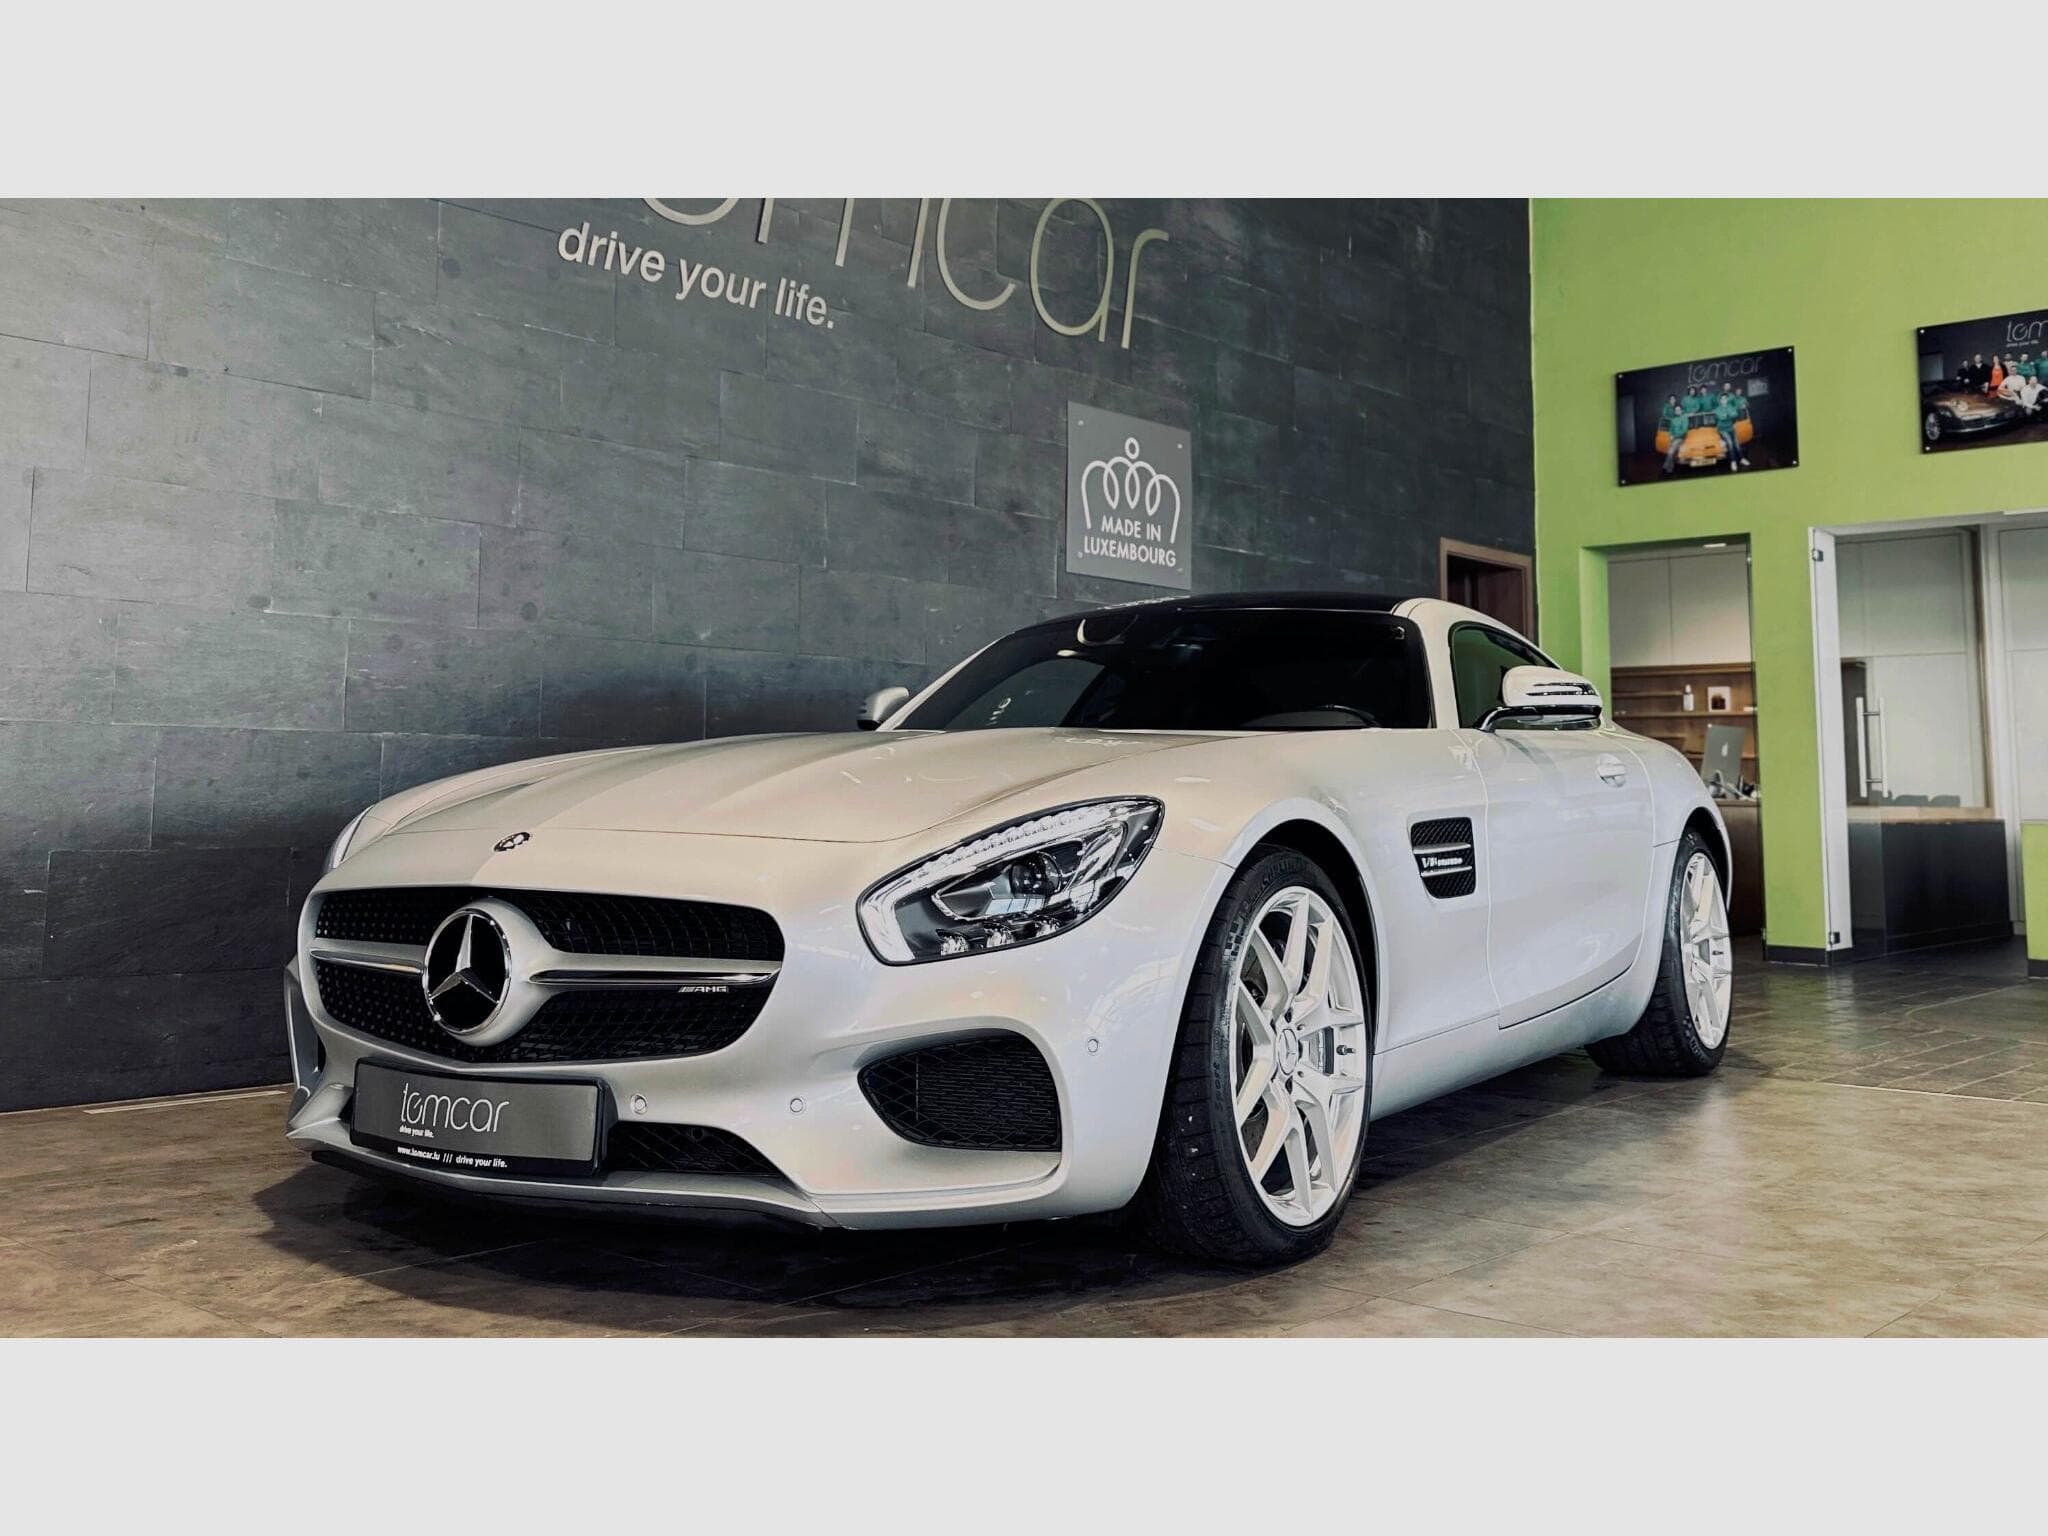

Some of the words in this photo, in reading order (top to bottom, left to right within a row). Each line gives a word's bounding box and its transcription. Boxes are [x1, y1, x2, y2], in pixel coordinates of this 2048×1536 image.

[558, 221, 665, 282] drive
[675, 258, 766, 309] your
[774, 277, 834, 329] life.
[642, 198, 1169, 350] car
[1101, 515, 1142, 538] MADE
[1146, 523, 1161, 542] IN
[1084, 535, 1176, 567] LUXEMBOURG
[693, 985, 727, 993] AMG
[400, 1082, 510, 1133] tomcar
[455, 1154, 474, 1165] drive
[474, 1158, 492, 1167] your
[493, 1157, 508, 1168] life.
